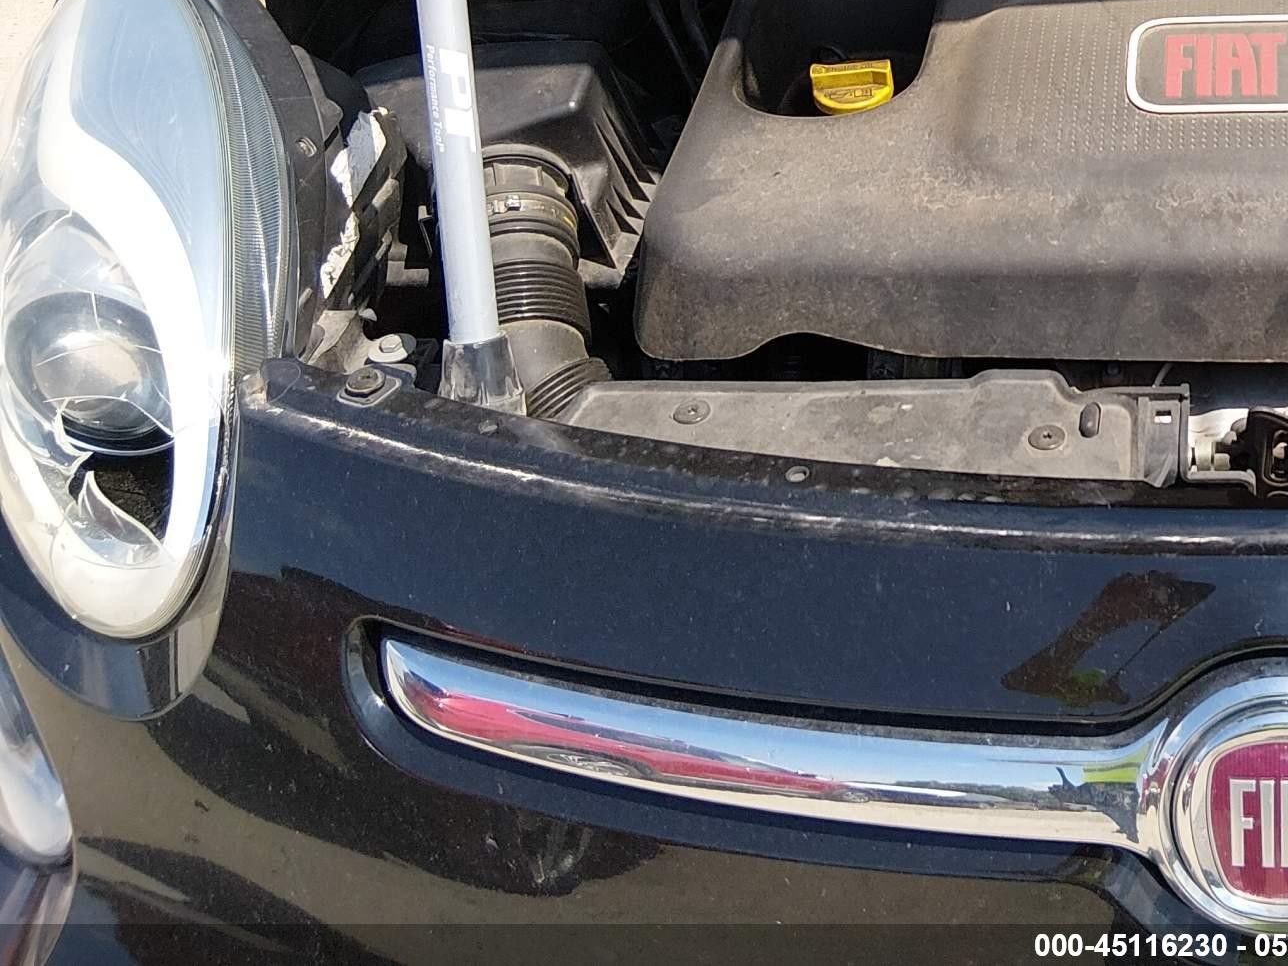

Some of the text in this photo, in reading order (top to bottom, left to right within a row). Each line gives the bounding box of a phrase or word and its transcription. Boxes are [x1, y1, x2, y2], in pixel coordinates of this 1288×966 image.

[426, 44, 440, 119] Performance
[439, 47, 477, 154] PT
[1163, 33, 1287, 98] FIAT
